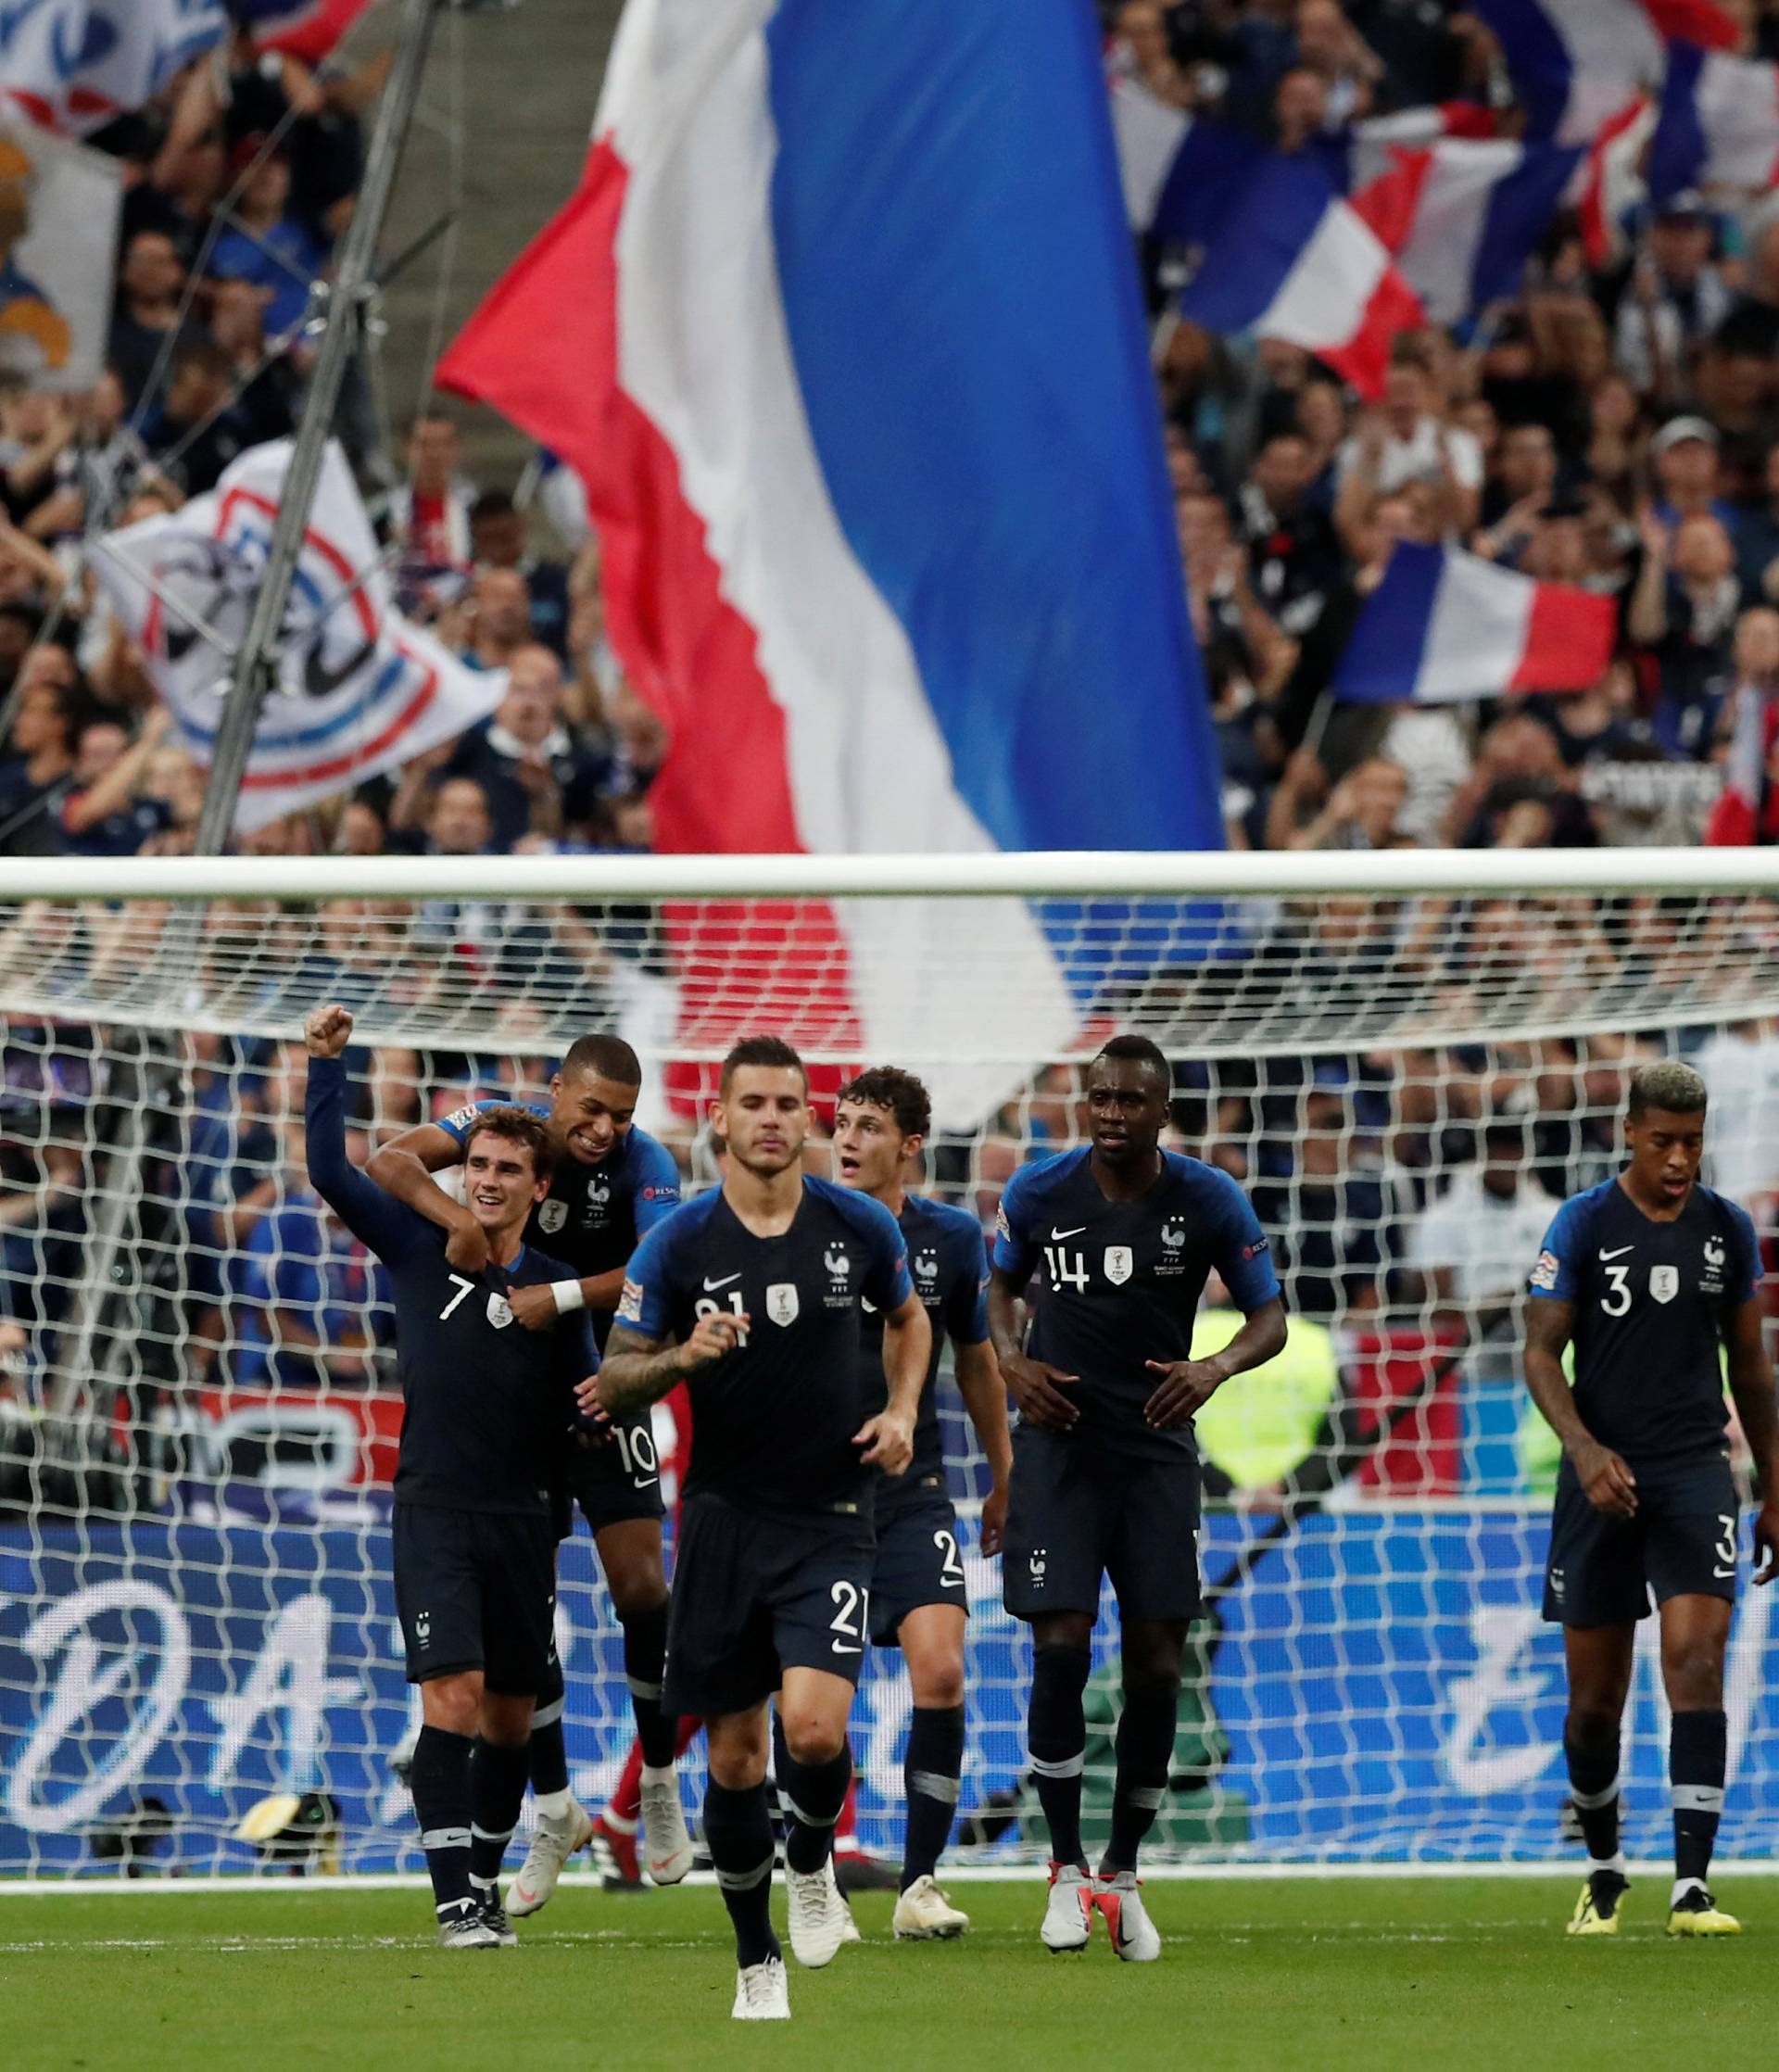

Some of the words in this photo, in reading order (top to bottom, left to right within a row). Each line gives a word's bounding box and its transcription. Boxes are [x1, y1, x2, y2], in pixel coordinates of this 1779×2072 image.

[1043, 1246, 1091, 1295] 14
[1600, 1265, 1633, 1318] 3
[439, 1273, 476, 1320] 7
[613, 1425, 656, 1473] 10
[933, 1529, 965, 1576] 2
[1715, 1514, 1737, 1564] 3
[830, 1580, 870, 1643] 21
